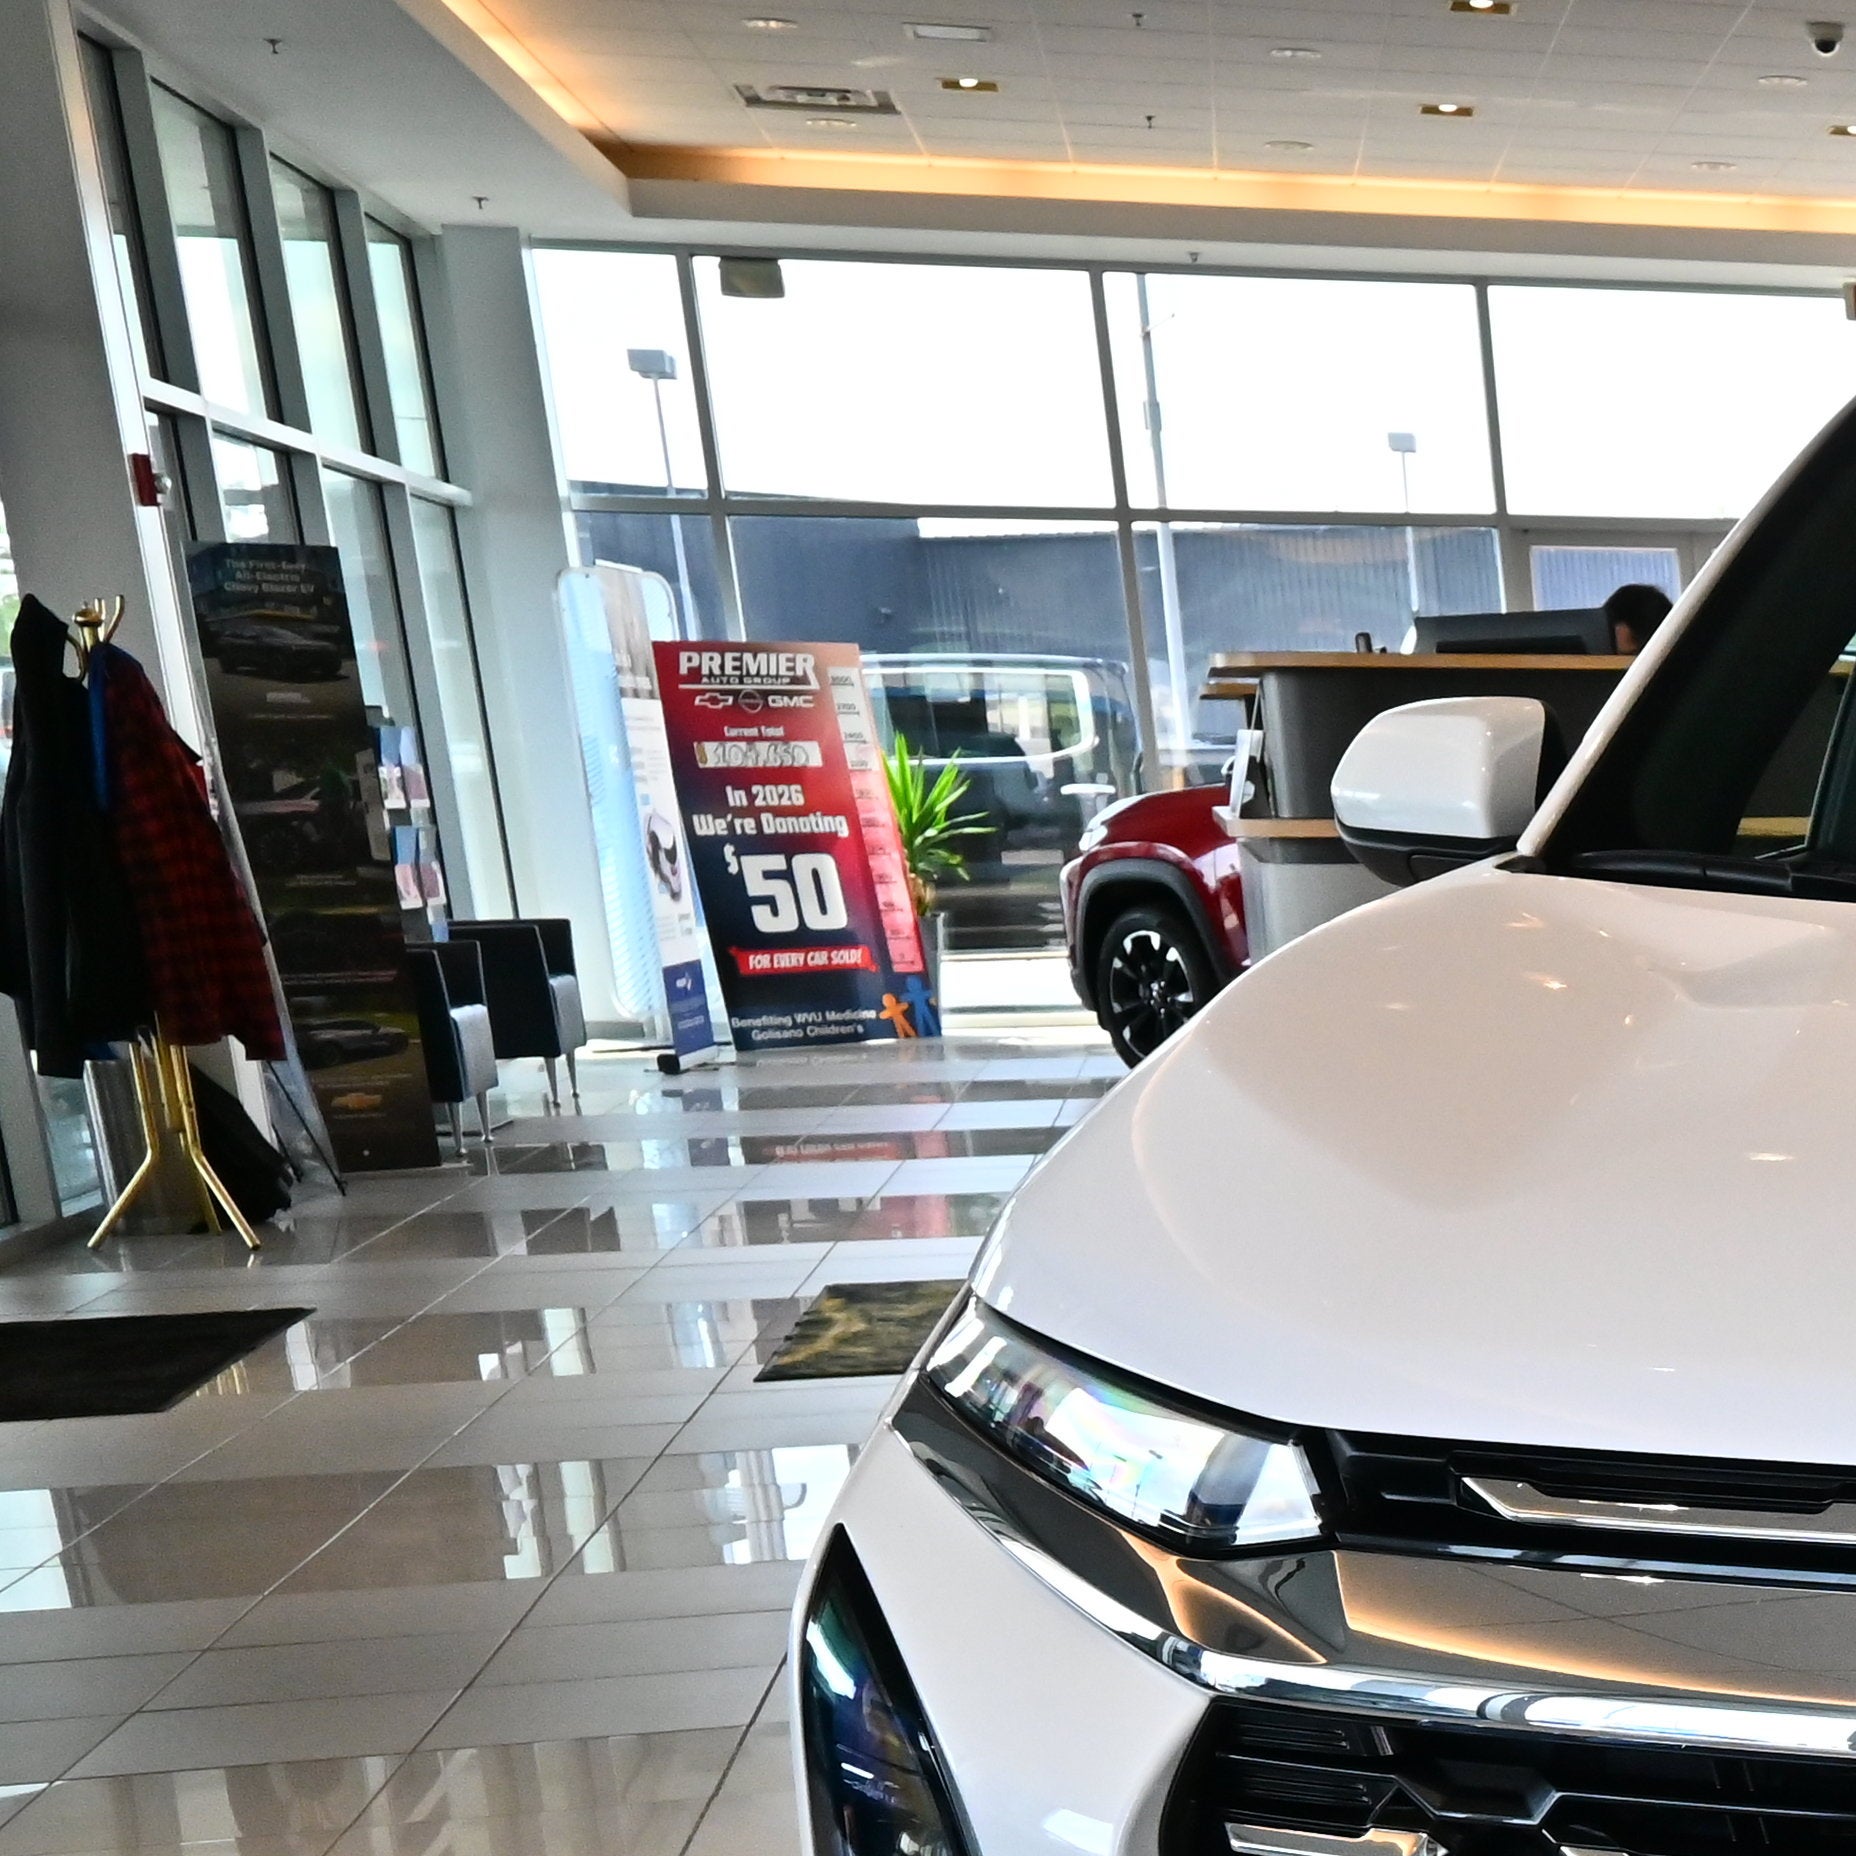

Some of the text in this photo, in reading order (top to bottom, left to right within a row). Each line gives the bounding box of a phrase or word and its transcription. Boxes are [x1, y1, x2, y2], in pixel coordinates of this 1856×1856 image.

[679, 651, 818, 679] PREMIER
[743, 677, 791, 685] GROUP
[768, 695, 814, 708] GMC
[725, 784, 805, 807] In 2026
[692, 811, 849, 838] We're Donating
[749, 948, 863, 970] FOR EVERY CAR SOLD!
[732, 1008, 877, 1029] Benefiting WVU Medicine
[752, 1023, 864, 1041] Golisano Children's
